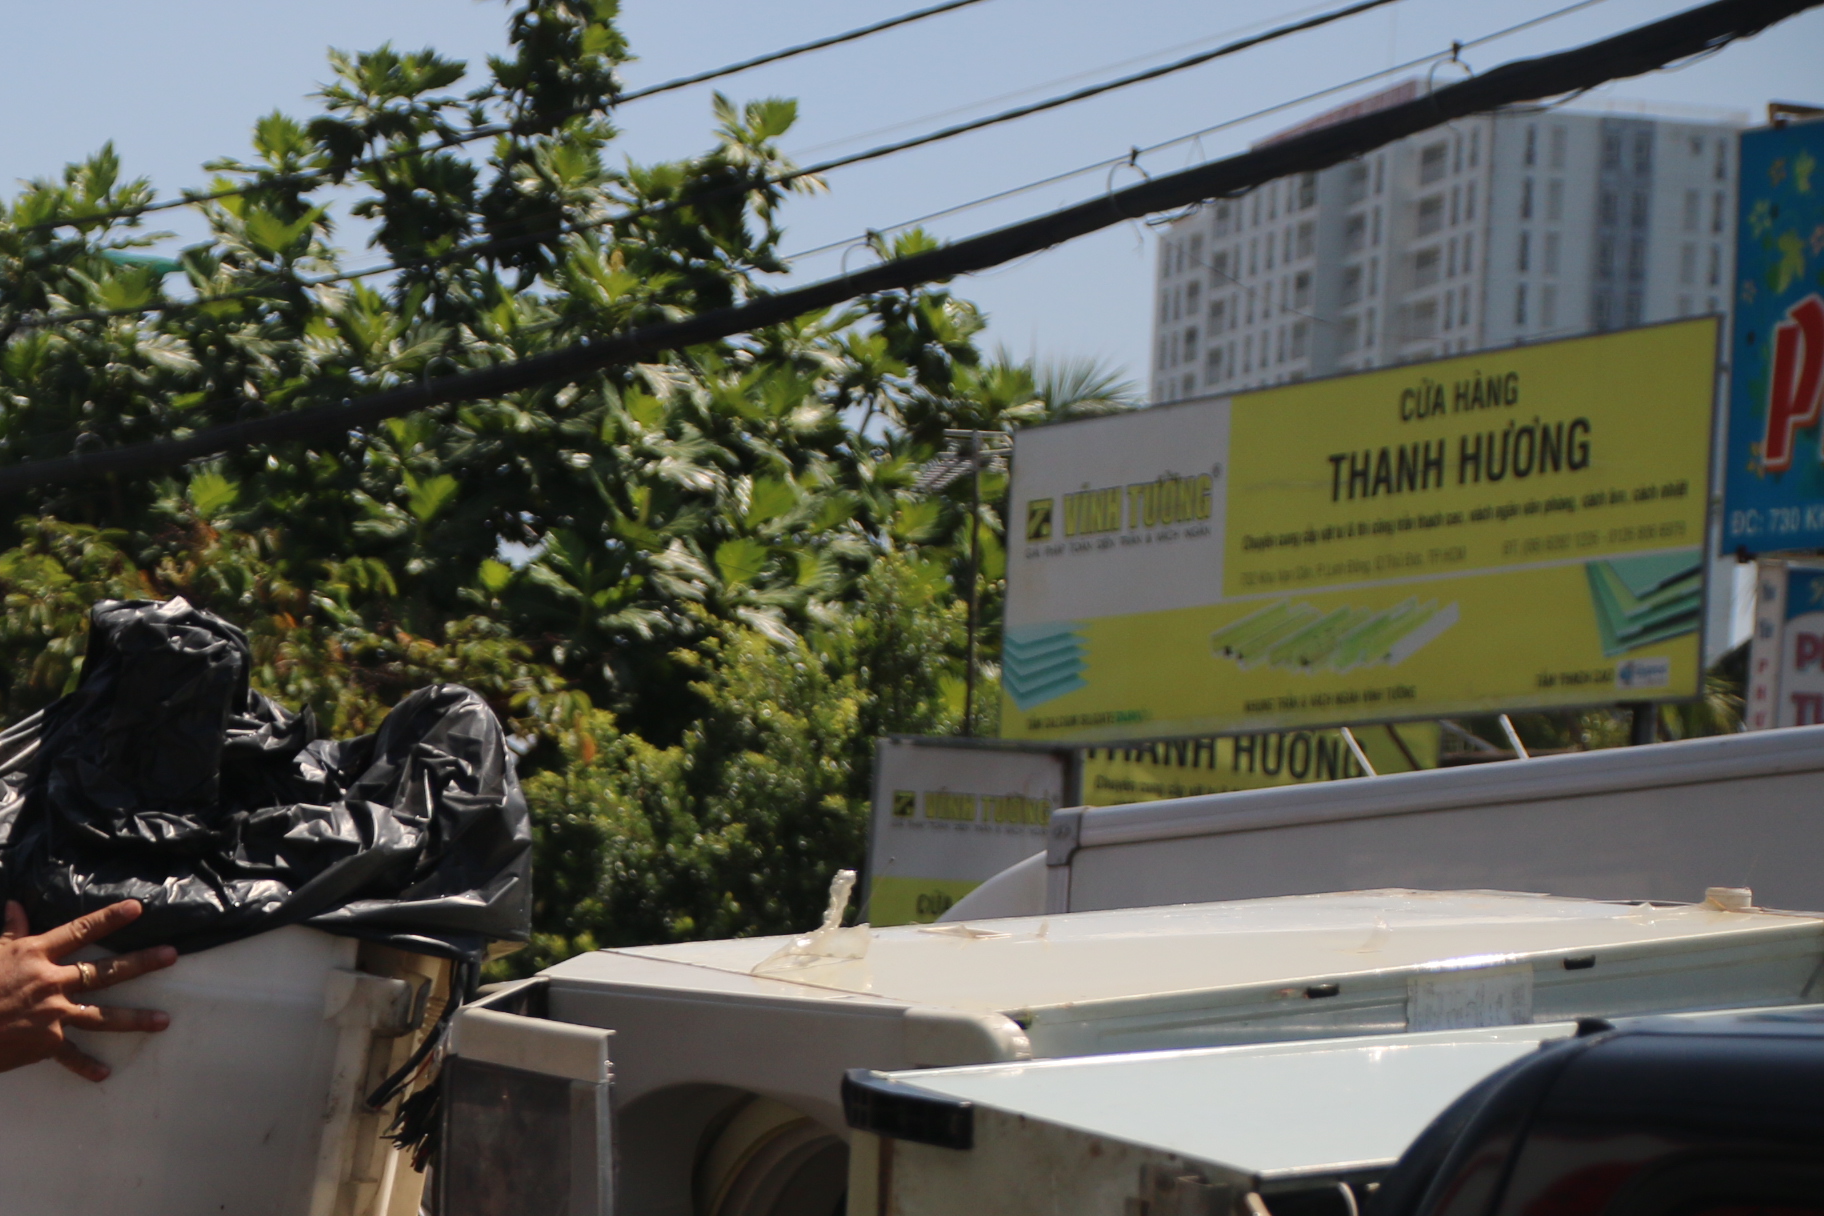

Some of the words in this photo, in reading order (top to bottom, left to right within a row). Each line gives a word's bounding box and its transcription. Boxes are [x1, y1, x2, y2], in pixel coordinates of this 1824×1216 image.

[1453, 369, 1519, 413] HÀNG
[1328, 437, 1446, 502] THANH
[1458, 415, 1592, 484] HƯƠNG
